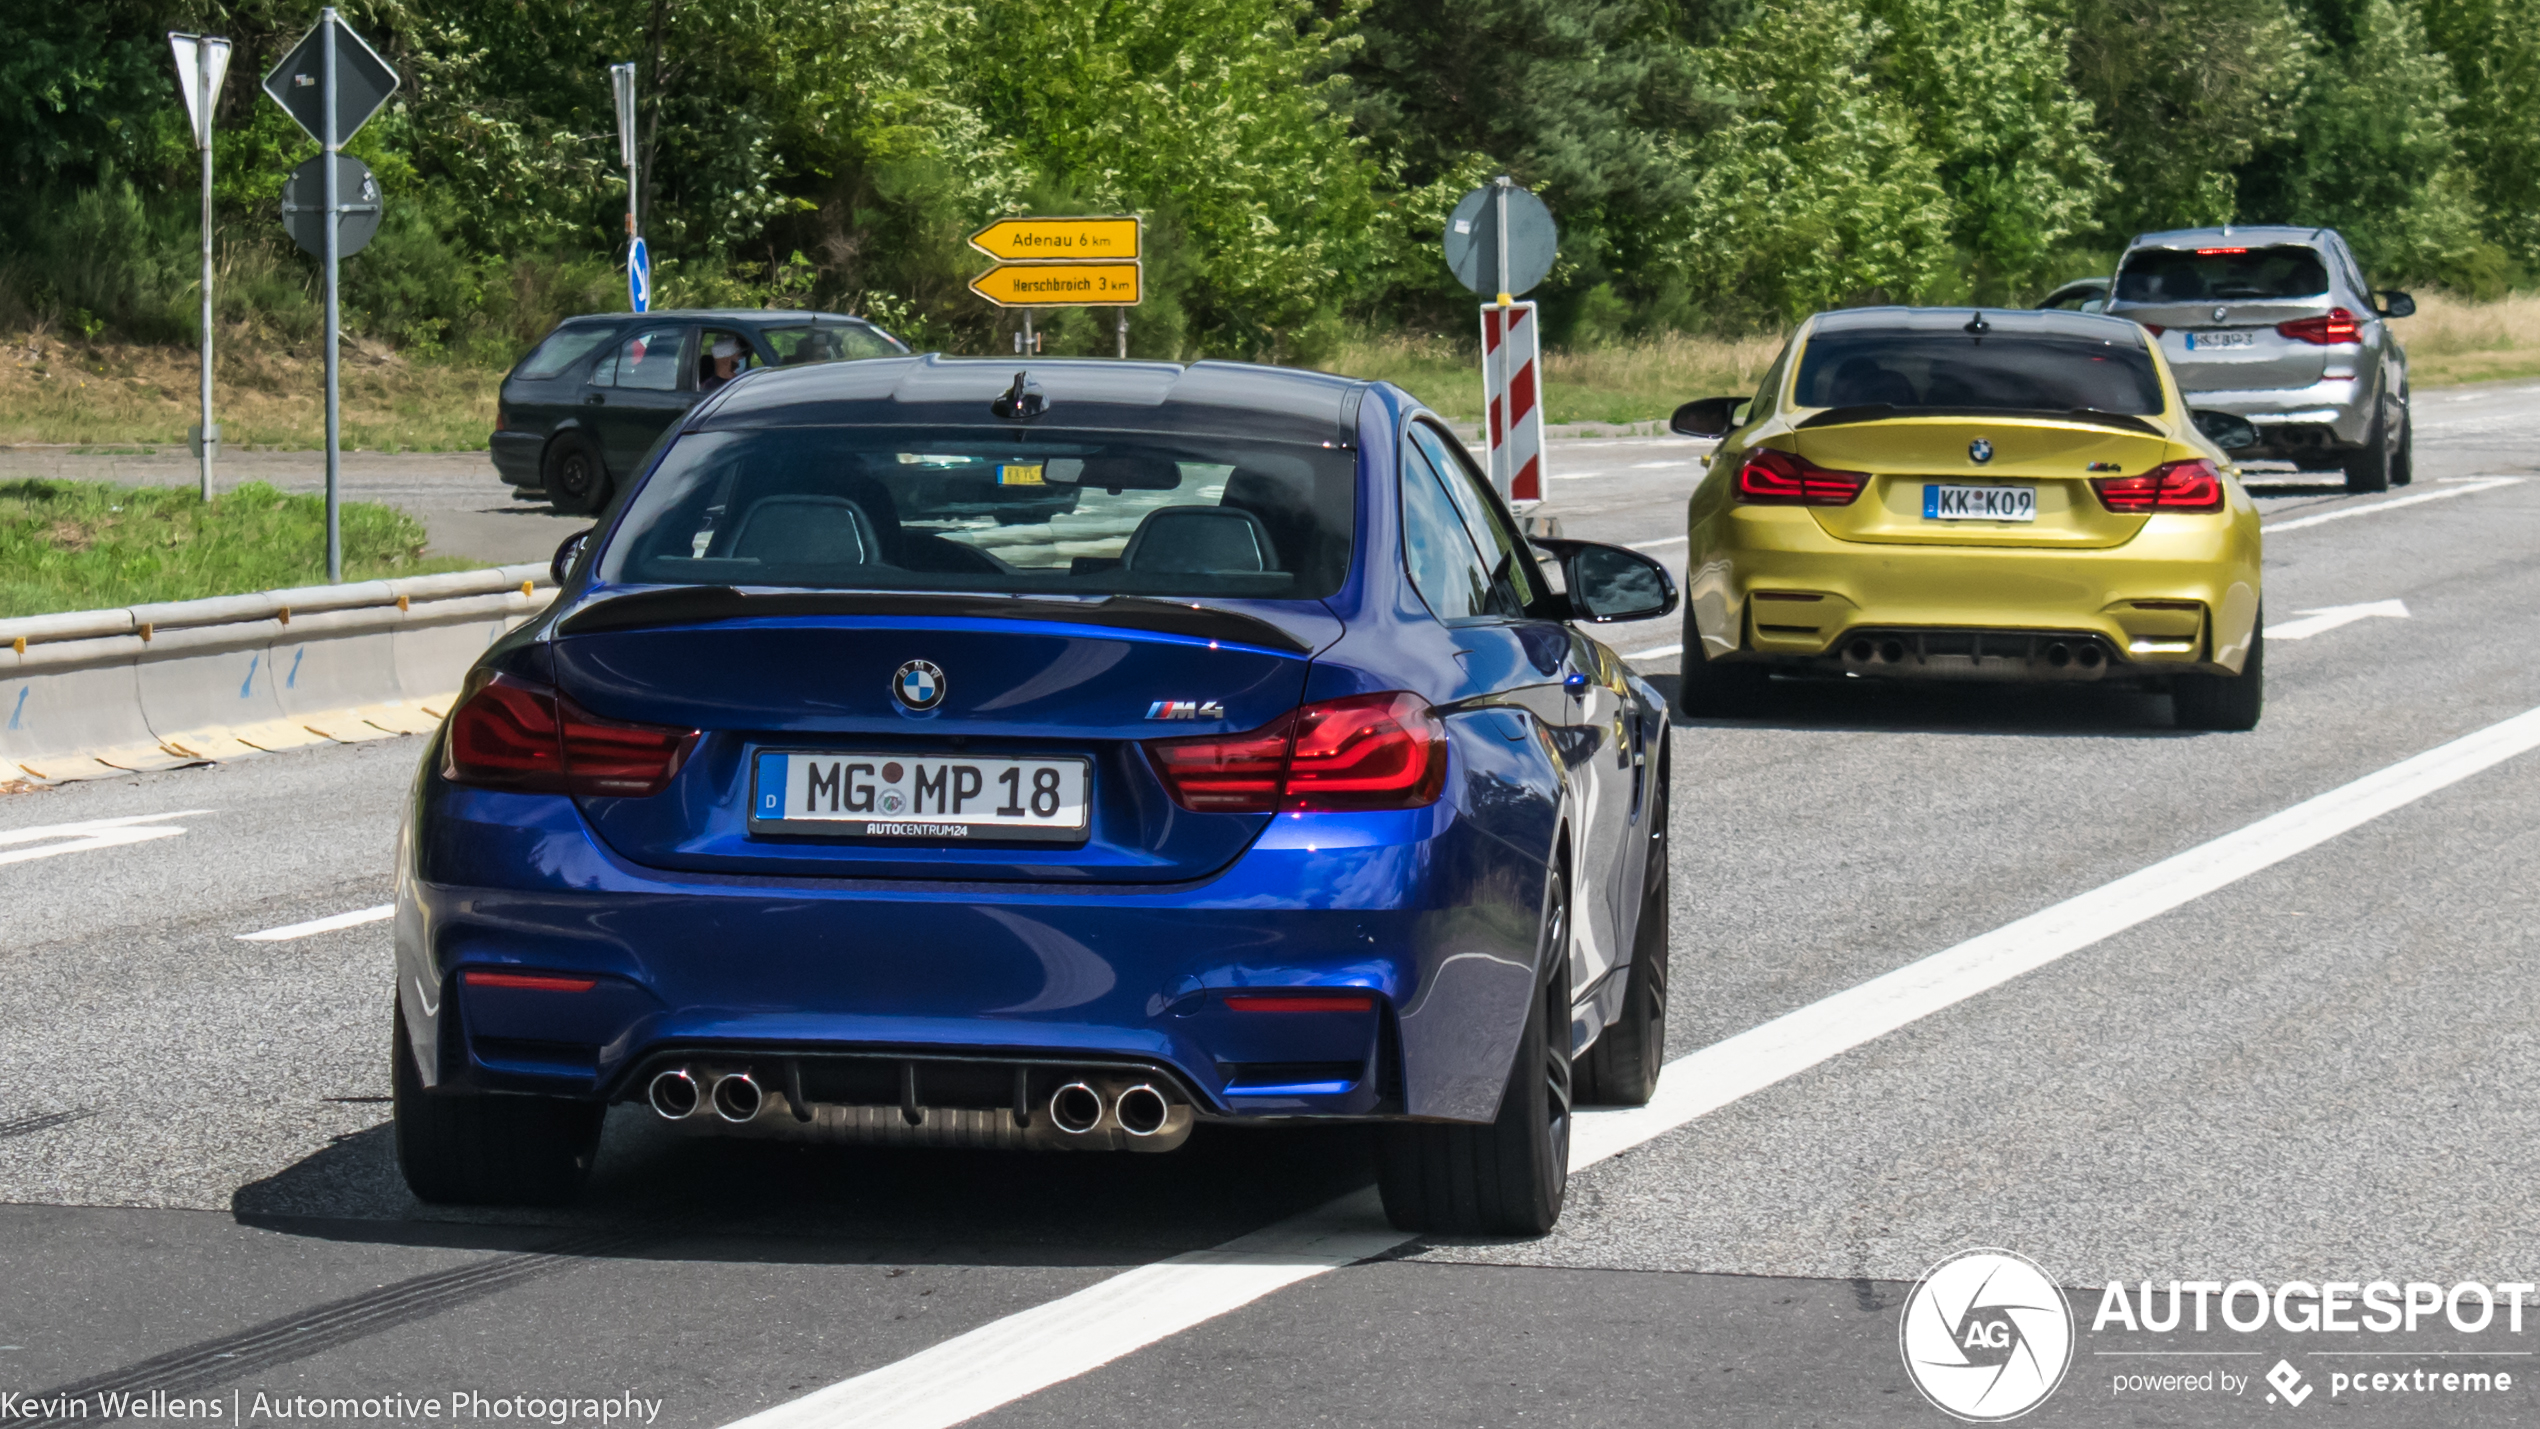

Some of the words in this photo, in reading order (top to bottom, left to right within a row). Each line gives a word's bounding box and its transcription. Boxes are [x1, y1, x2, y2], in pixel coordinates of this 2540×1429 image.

[1012, 233, 1072, 247] Adenau
[1079, 233, 1088, 247] 6
[1092, 235, 1111, 247] km
[1013, 277, 1091, 292] Herschbroich
[1098, 276, 1107, 291] 3
[1111, 280, 1130, 291] km
[1941, 490, 1969, 514] KK
[897, 660, 942, 679] BMW
[807, 762, 875, 813] MG
[914, 764, 983, 815] MP
[996, 767, 1061, 818] 18
[765, 794, 777, 809] D
[867, 822, 968, 837] AUTOCENTRUM24
